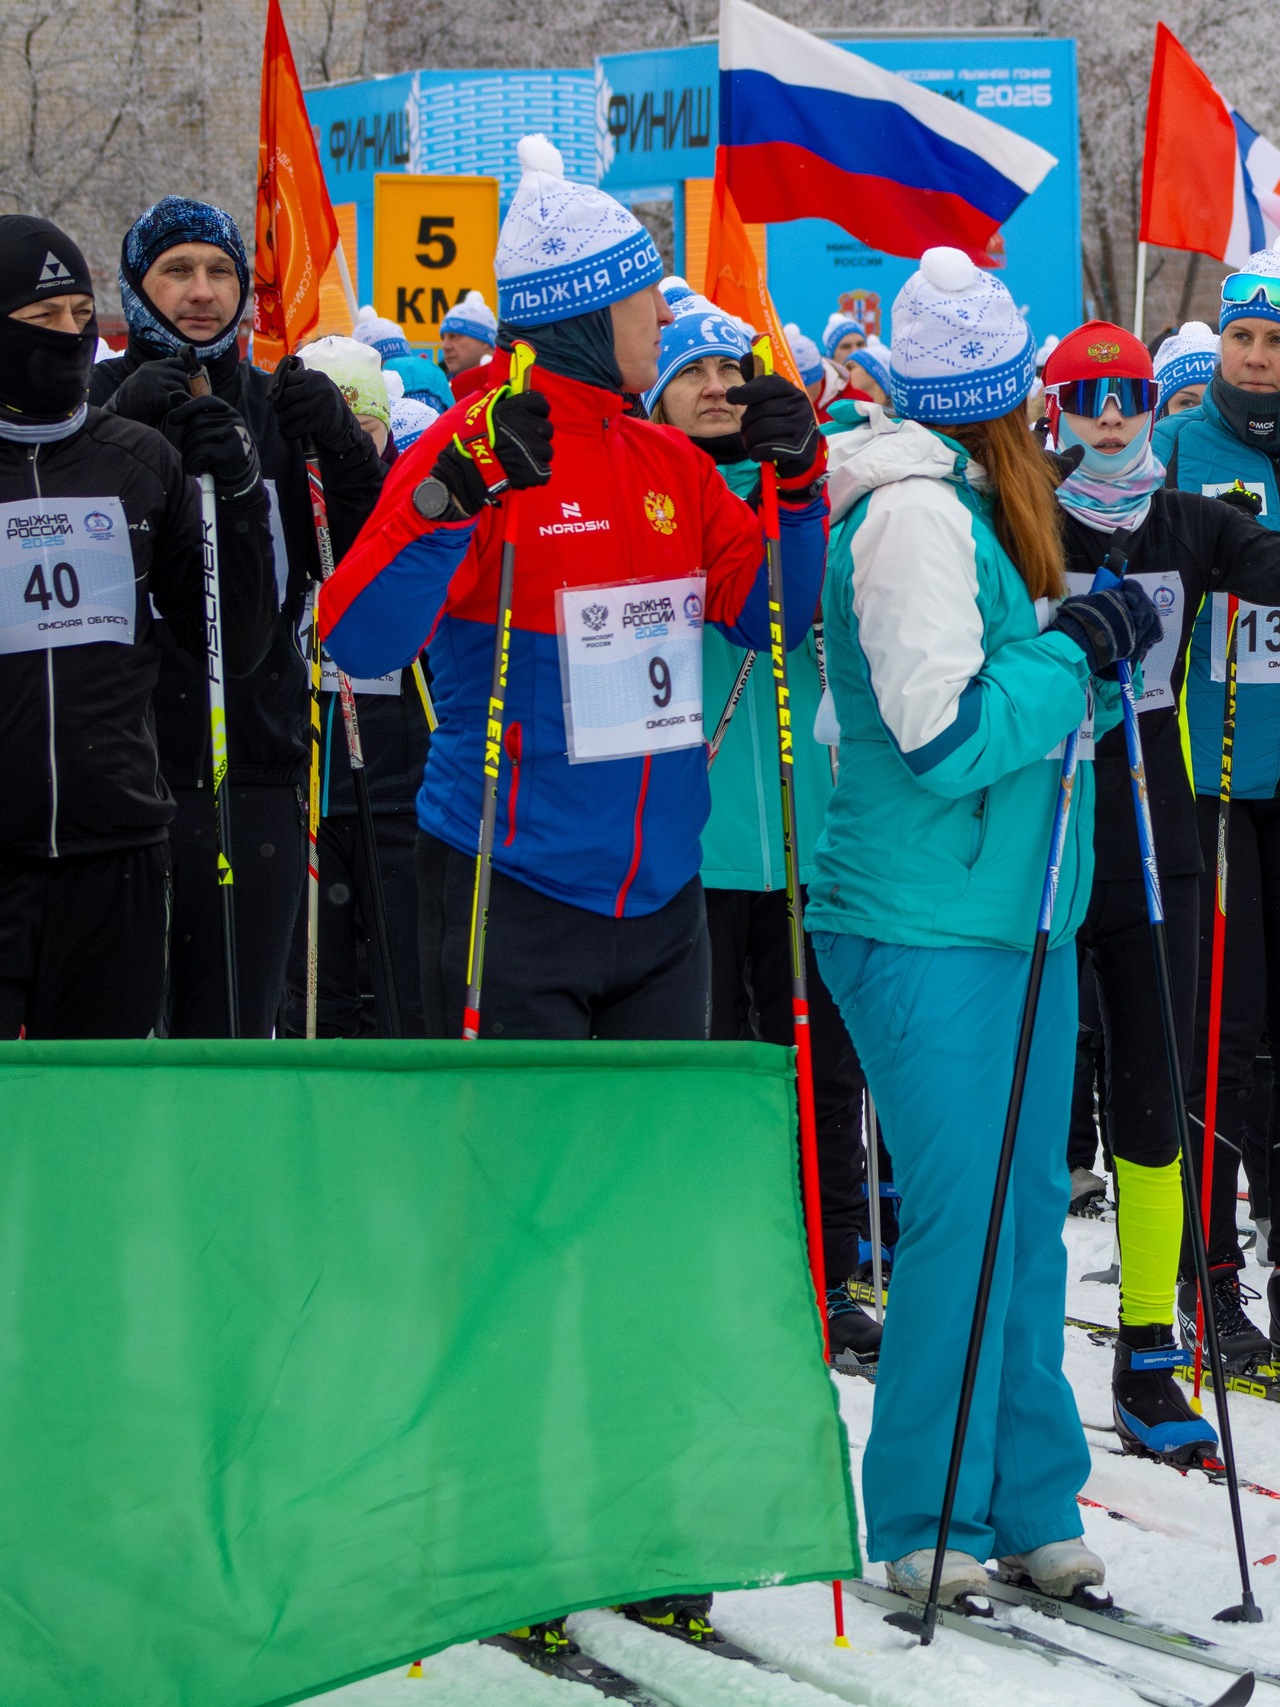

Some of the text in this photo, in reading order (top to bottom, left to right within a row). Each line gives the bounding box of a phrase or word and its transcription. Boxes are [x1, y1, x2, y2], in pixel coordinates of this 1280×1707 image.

[975, 83, 1053, 107] 2025
[608, 87, 711, 154] ФИНИШ
[330, 110, 410, 174] ФИНИШ
[415, 216, 457, 269] 5
[510, 268, 611, 311] ЛЫЖНЯ
[918, 376, 1017, 411] ЛЫЖНЯ
[1249, 421, 1275, 430] ОМСК
[6, 524, 74, 540] РОССИИ
[8, 513, 69, 528] ЛЫЖНЯ
[539, 520, 611, 537] NORDSKI
[22, 535, 66, 550] 2025
[24, 562, 80, 611] 40
[202, 520, 220, 684] FISCHER
[624, 598, 672, 615] ЛЫЖНЯ
[38, 616, 129, 631] ОМСКАЯ ОБЛАСТЬ
[622, 610, 676, 628] РОССИИ
[635, 624, 669, 639] 2025
[649, 656, 672, 708] 9
[646, 715, 686, 729] ОМСКАЯ
[777, 685, 794, 765] LEKI
[484, 696, 505, 778] LEKI
[1220, 736, 1233, 803] LEKI
